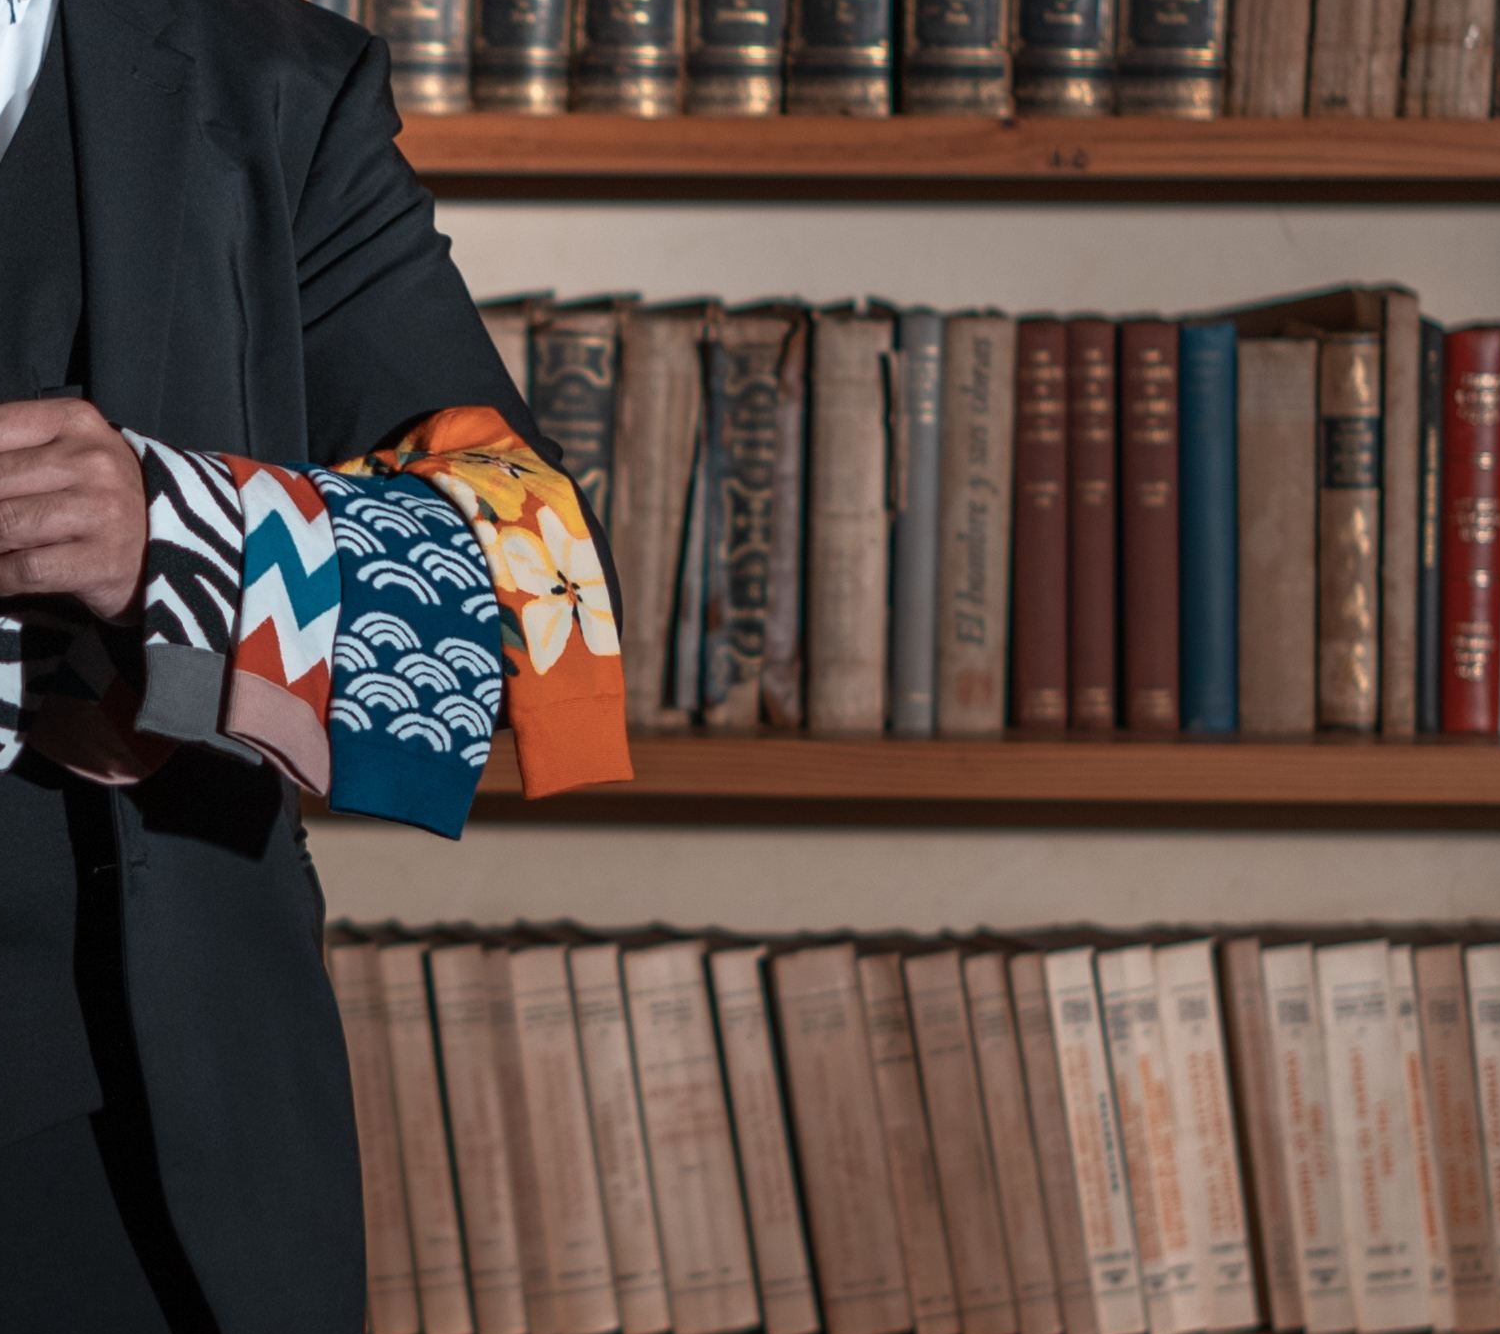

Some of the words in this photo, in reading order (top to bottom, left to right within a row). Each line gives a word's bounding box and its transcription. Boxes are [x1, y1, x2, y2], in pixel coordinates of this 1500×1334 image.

[962, 335, 994, 414] obras
[968, 427, 989, 467] sus
[959, 509, 991, 606] hombre
[956, 610, 986, 647] El
